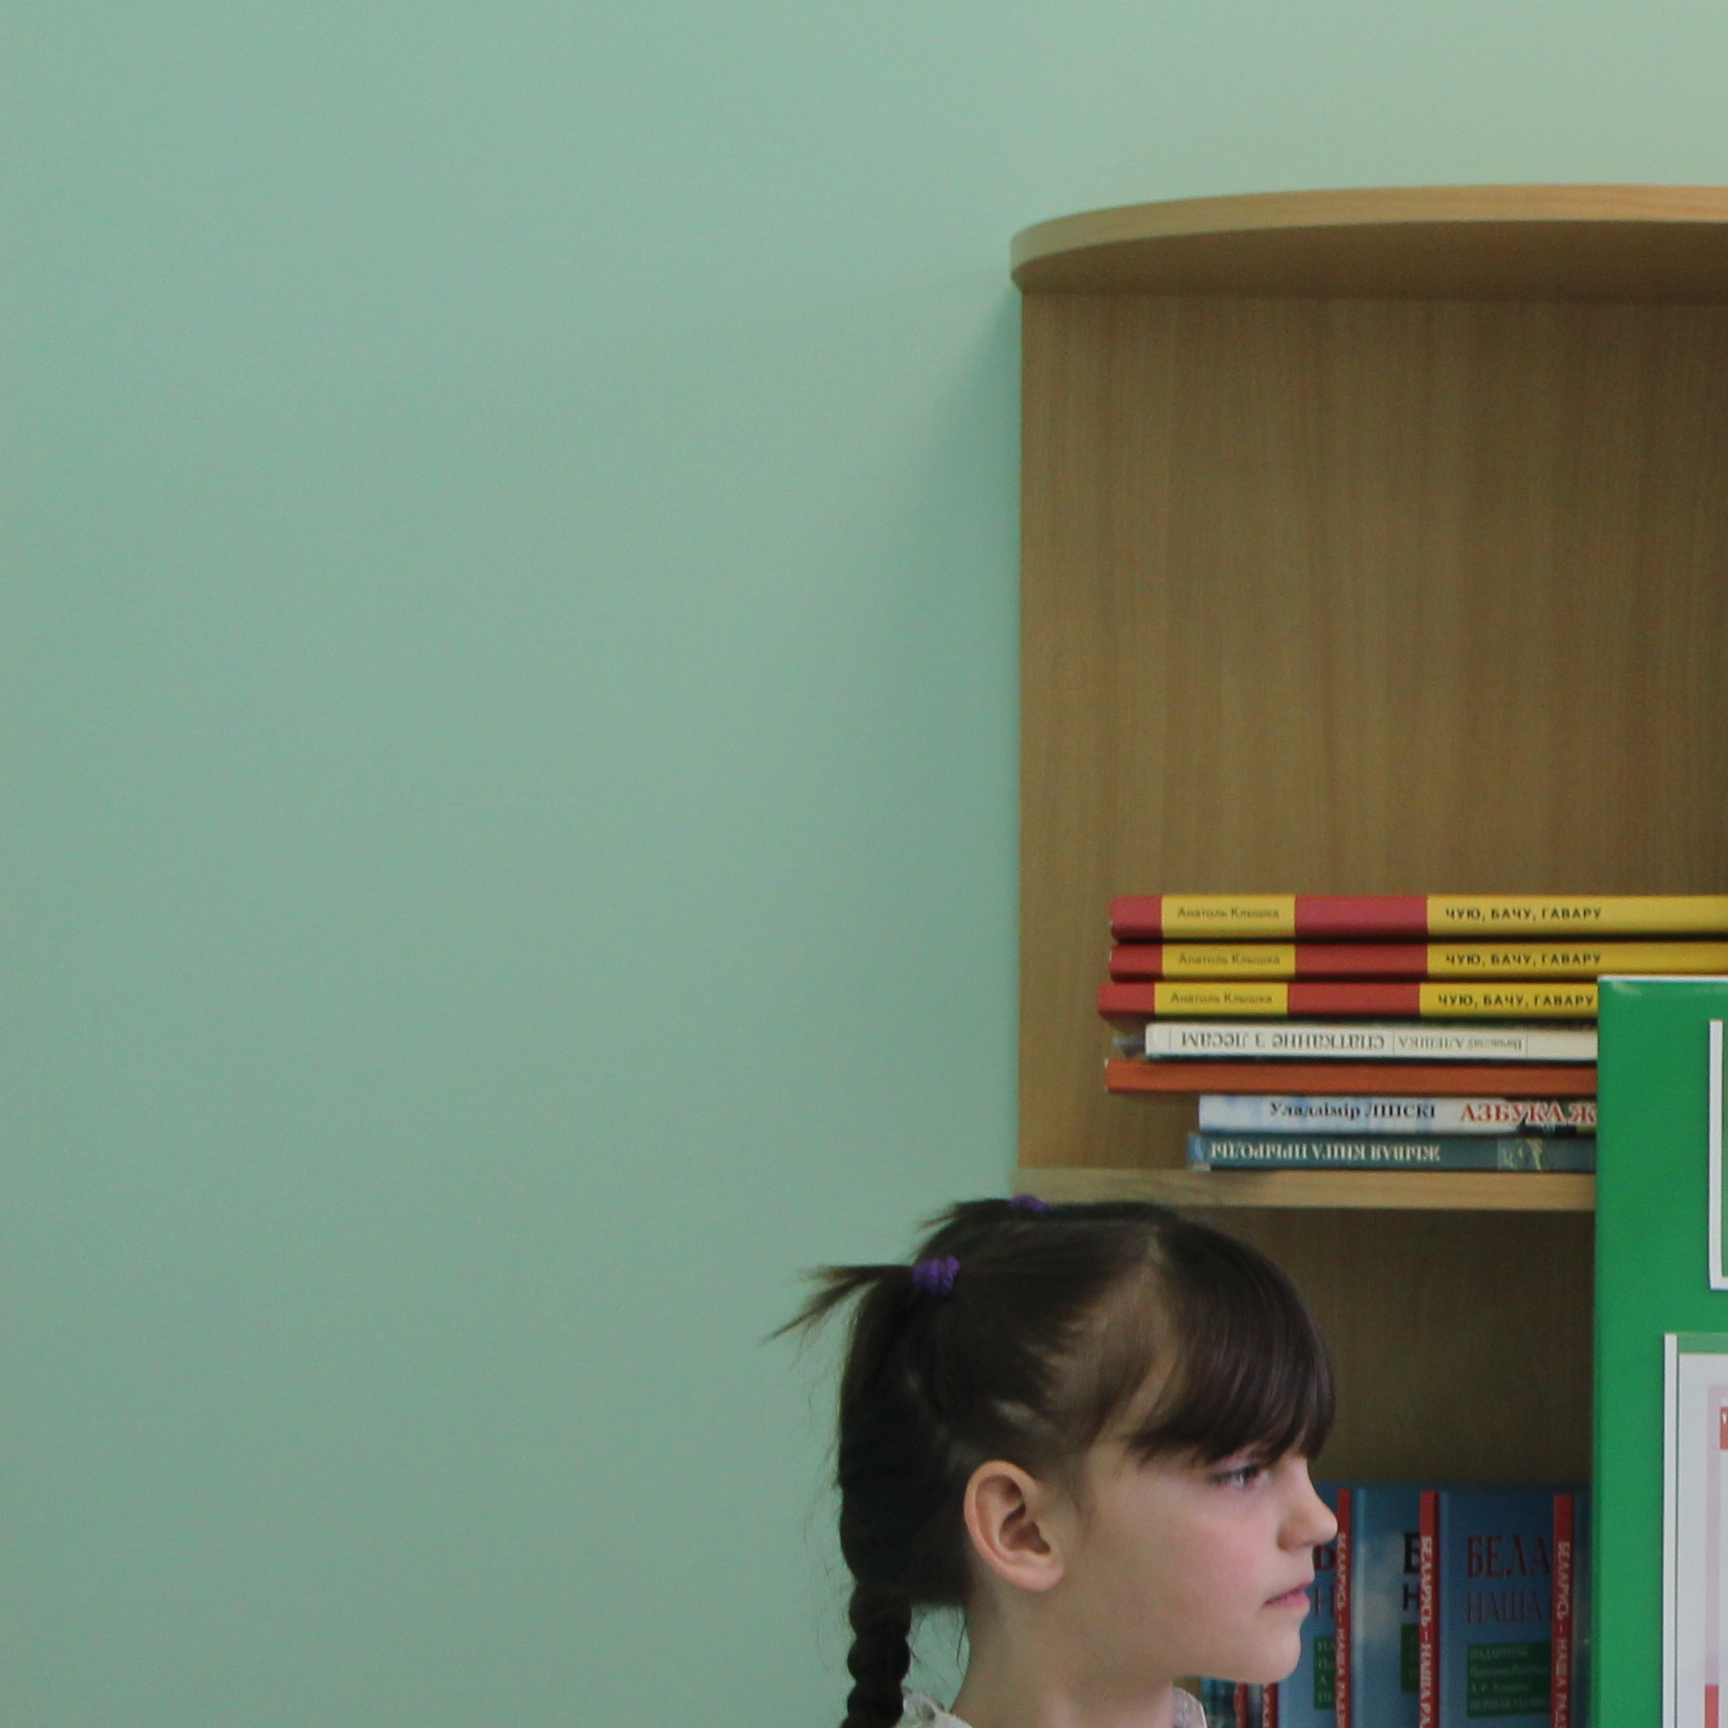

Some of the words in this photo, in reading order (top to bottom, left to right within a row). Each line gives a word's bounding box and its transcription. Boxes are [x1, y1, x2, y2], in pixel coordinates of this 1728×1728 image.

[1446, 908, 1487, 923] ЧУЮ,
[1491, 908, 1538, 923] БАЧУ,
[1541, 908, 1603, 922] ГАВАРУ
[1446, 953, 1487, 967] ЧУЮ,
[1491, 953, 1538, 967] БАЧУ,
[1541, 953, 1603, 966] ГАВАРУ
[1438, 994, 1479, 1009] ЧУЮ,
[1483, 994, 1529, 1009] БАЧУ,
[1534, 994, 1596, 1008] ГАВАРУ
[1269, 1101, 1361, 1121] Уладзімір
[1458, 1102, 1566, 1126] АЗБУКА
[1210, 1141, 1309, 1162] ПРЫРОДЫ
[1369, 1142, 1441, 1163] ЖЫВАЯ
[1420, 1535, 1432, 1626] БЕЛАРУСЬ
